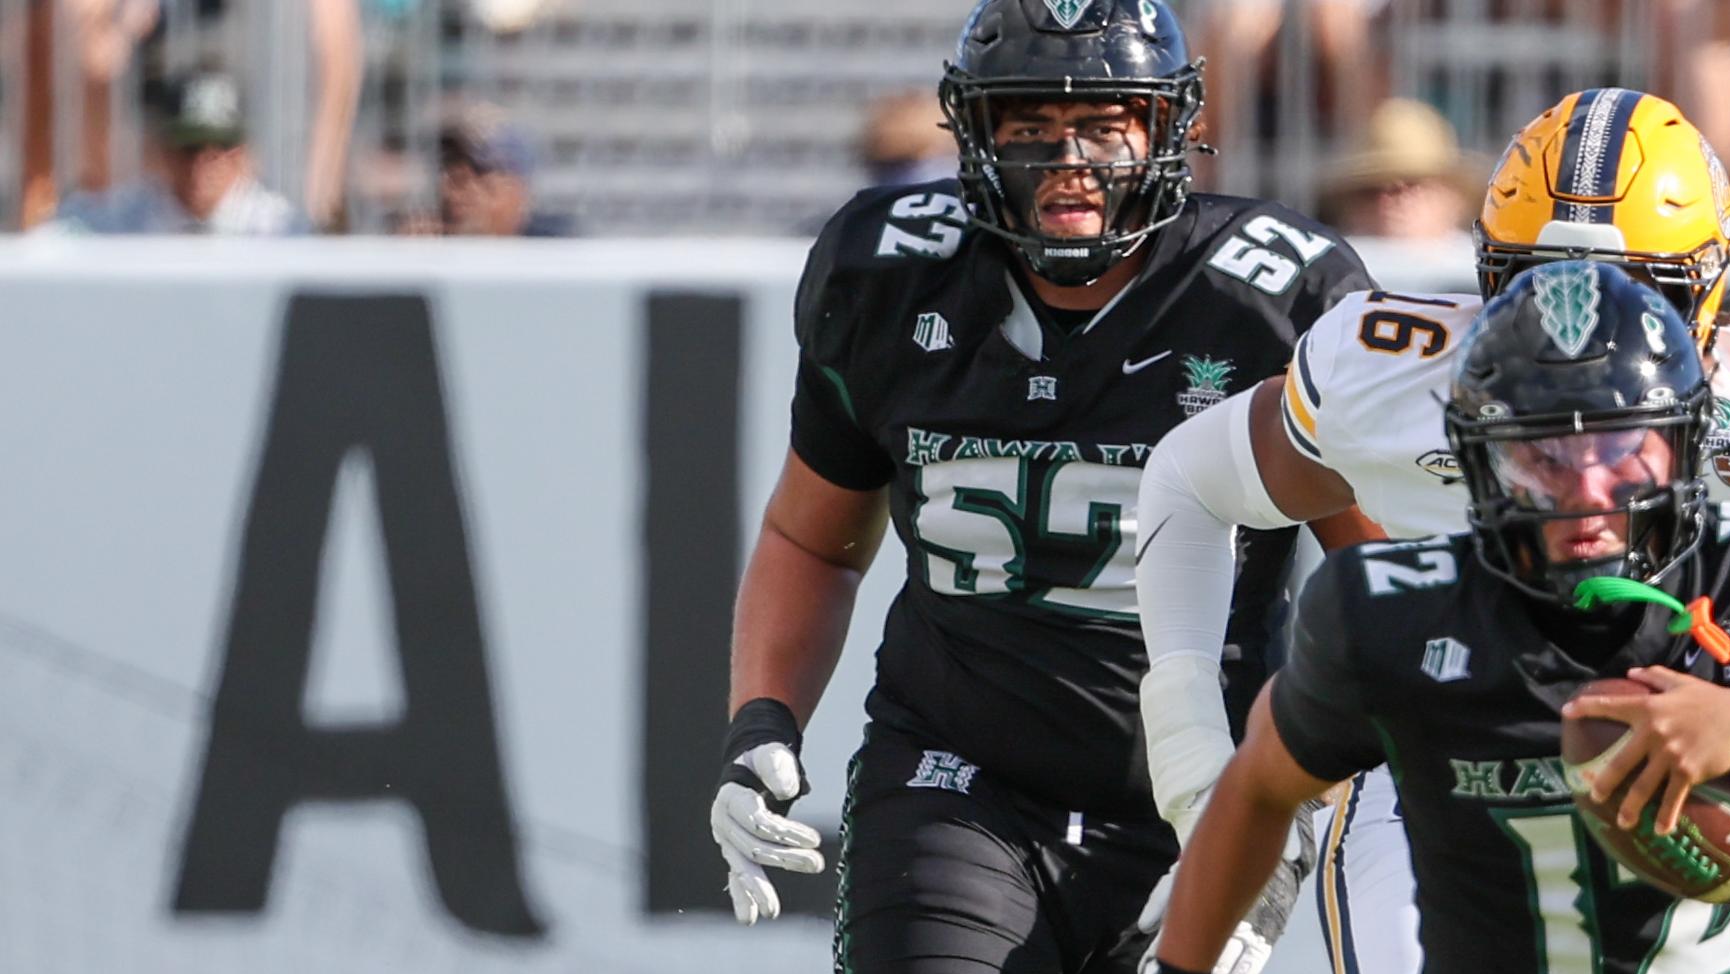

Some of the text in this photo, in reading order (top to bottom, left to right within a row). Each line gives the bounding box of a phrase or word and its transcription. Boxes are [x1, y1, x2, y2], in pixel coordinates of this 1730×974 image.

[874, 192, 968, 258] 52
[1205, 214, 1337, 296] 52
[912, 456, 1142, 622] 52
[1359, 533, 1458, 596] 12
